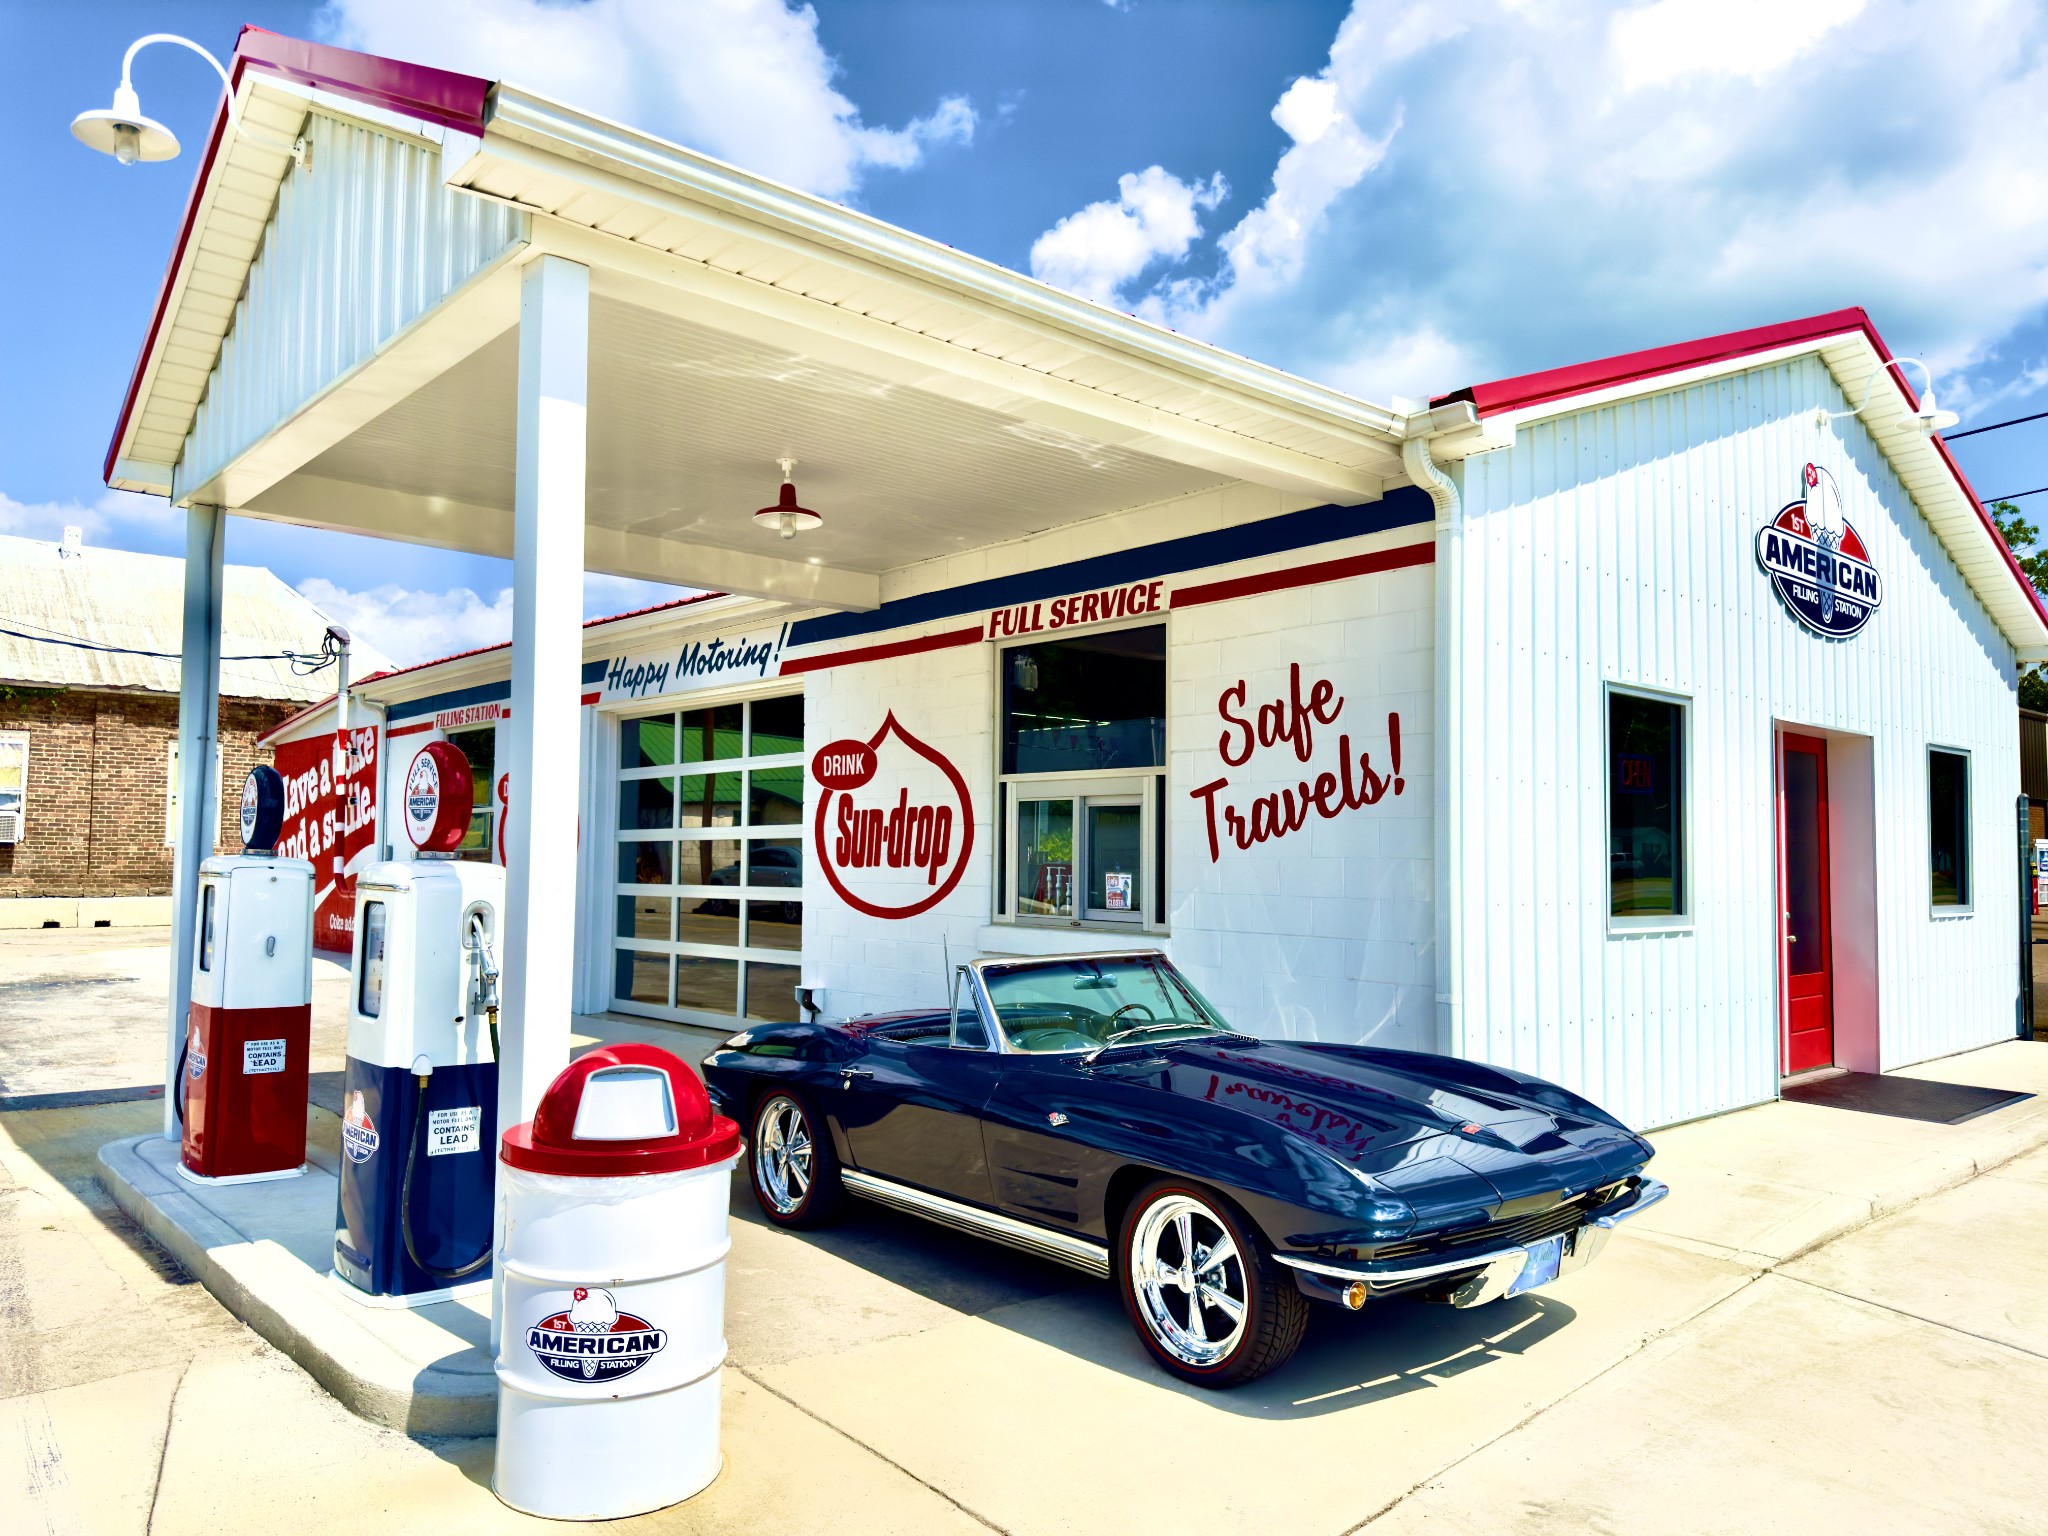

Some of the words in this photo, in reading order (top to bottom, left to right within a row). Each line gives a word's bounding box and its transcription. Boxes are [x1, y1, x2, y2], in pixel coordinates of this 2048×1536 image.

[1790, 513, 1806, 533] 1ST
[1765, 533, 1877, 601] AMERICAN
[989, 603, 1044, 638] FULL
[1049, 581, 1164, 629] SERVICE
[1792, 584, 1819, 605] FILLING
[1834, 599, 1862, 619] STATION
[608, 656, 670, 698] Happy
[675, 621, 788, 678] Motoring!
[436, 712, 464, 728] FILLING
[465, 703, 501, 724] STATION
[1218, 662, 1344, 767] Safe
[823, 753, 865, 777] DRINK
[320, 758, 331, 797] a
[1189, 712, 1405, 864] Travels!
[409, 796, 437, 807] AMERICAN
[310, 820, 321, 858] a
[248, 1051, 282, 1059] CONTAINS
[253, 1058, 277, 1067] LEAD
[433, 1123, 475, 1135] CONTAINS
[440, 1133, 468, 1145] LEAD
[553, 1319, 567, 1330] 1ST
[529, 1331, 660, 1354] AMERICAN
[551, 1360, 580, 1369] FILLING
[600, 1359, 637, 1369] STATION
